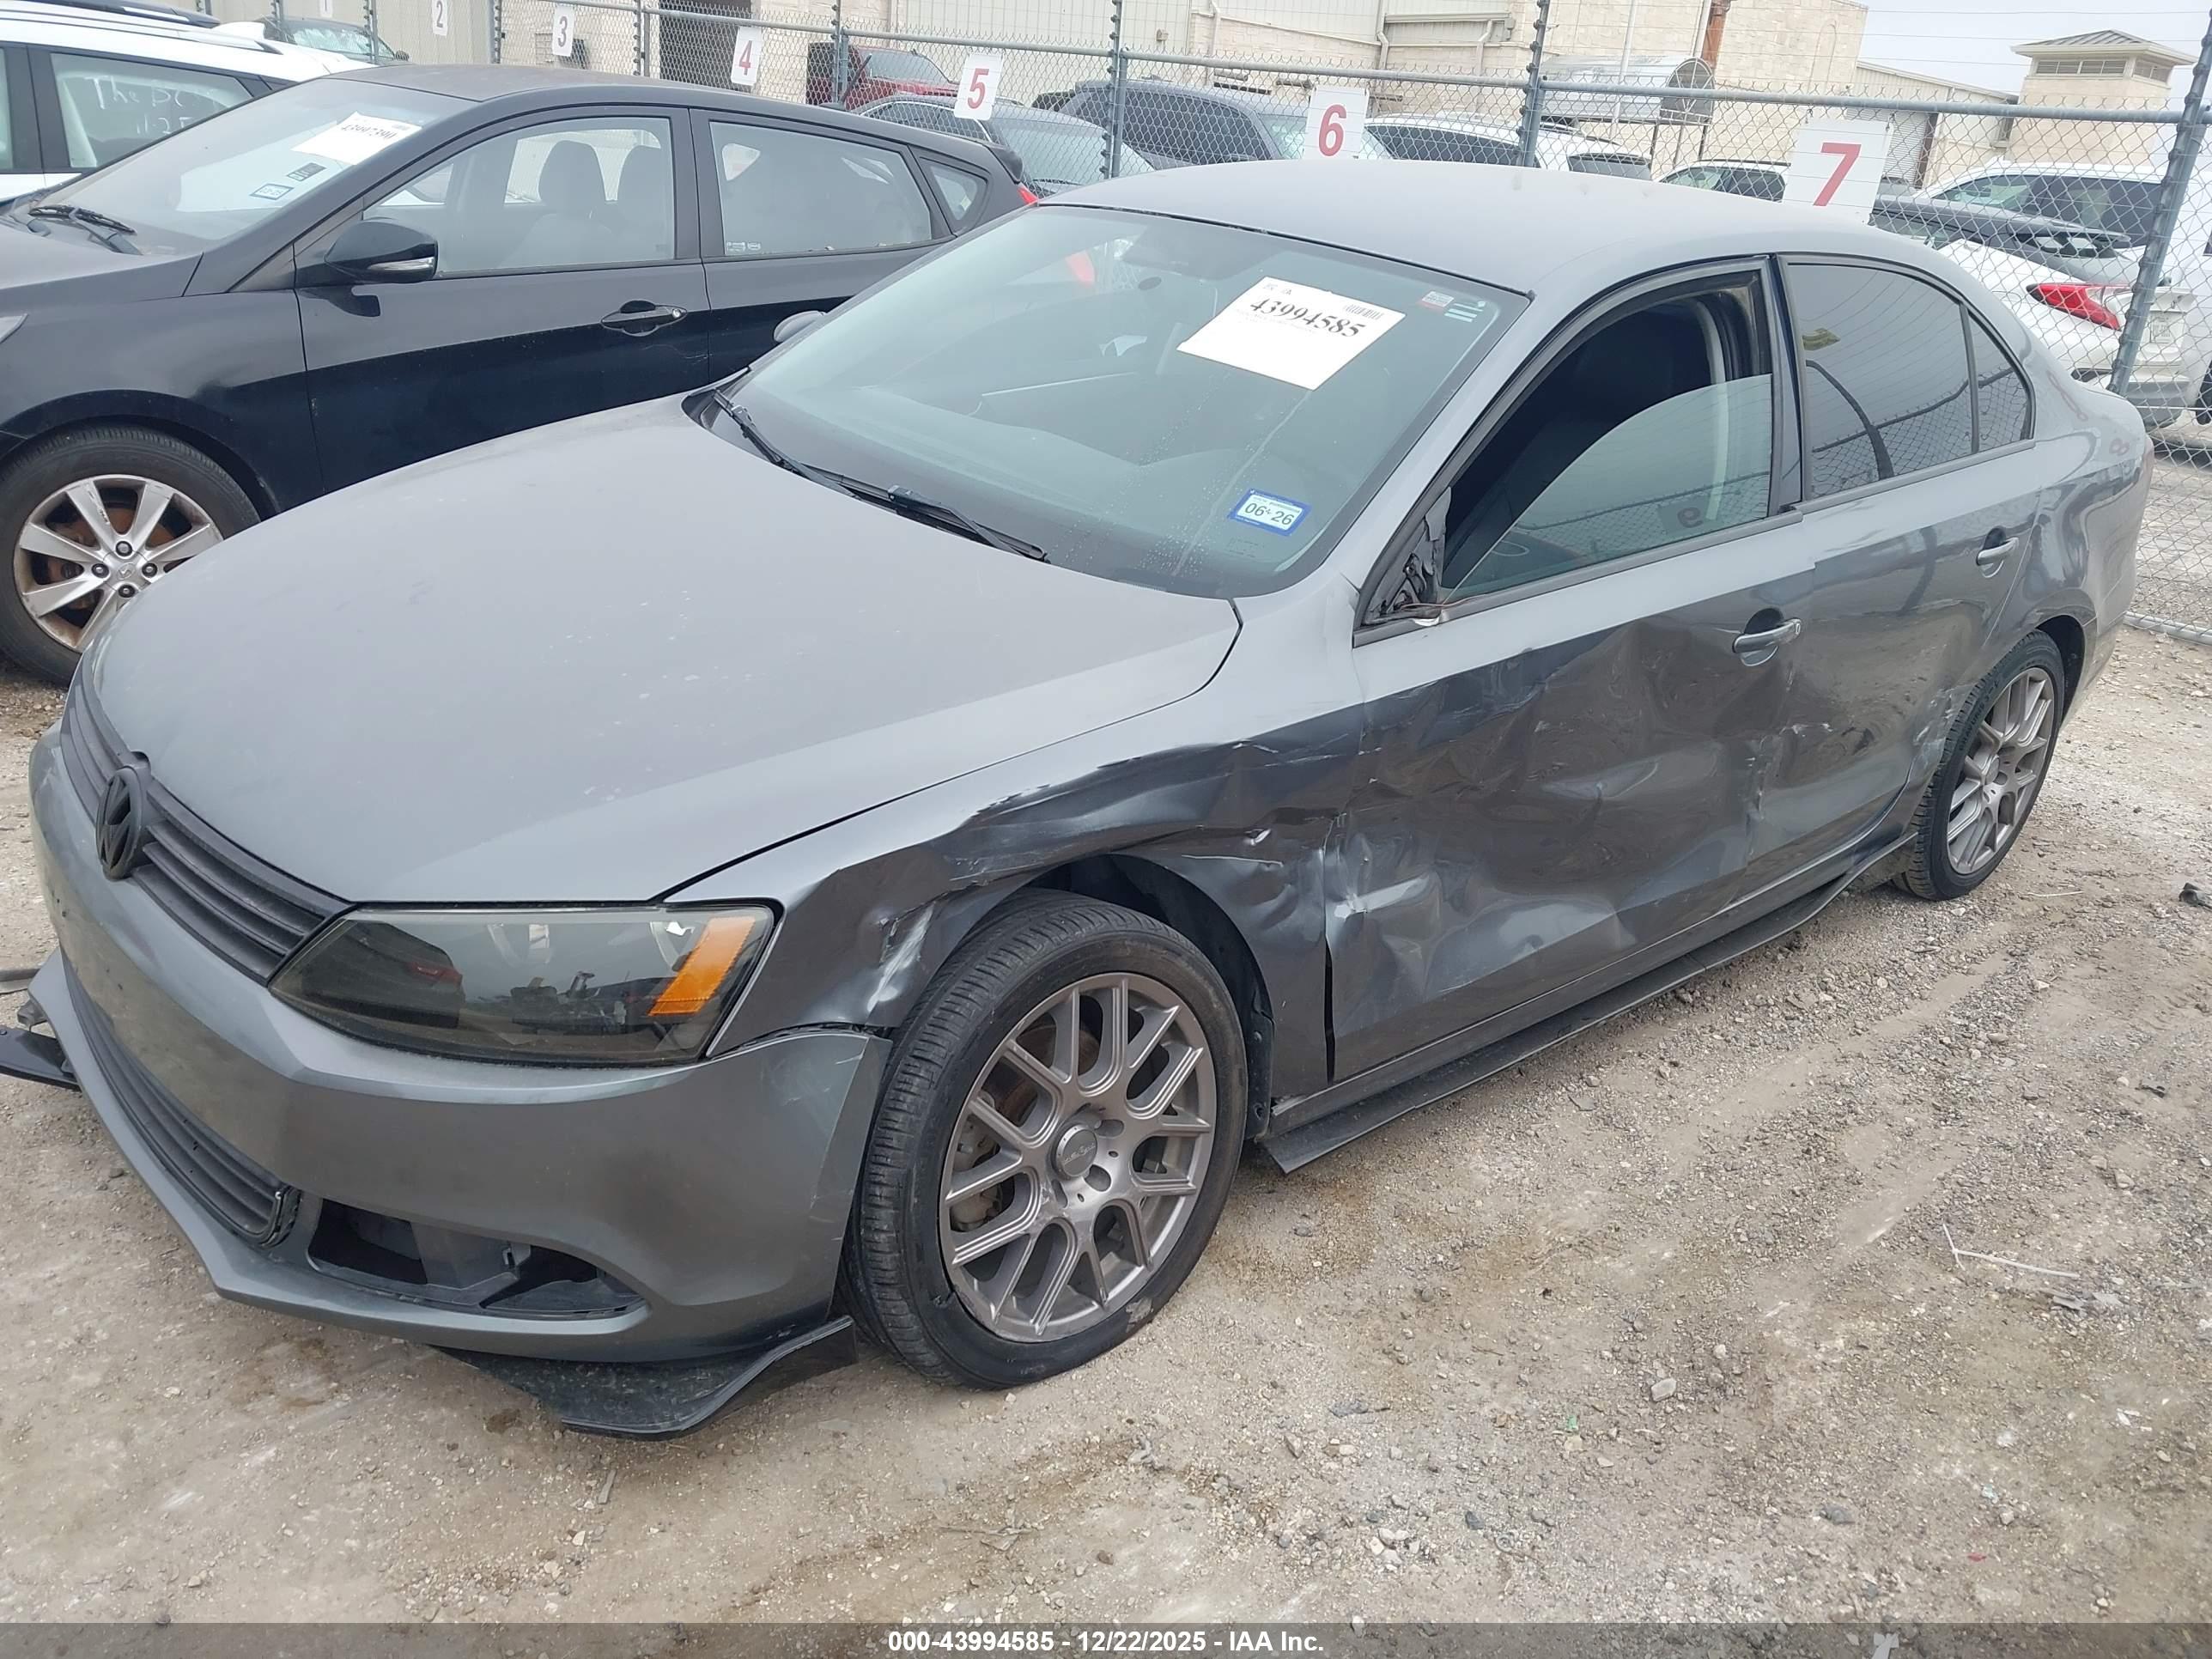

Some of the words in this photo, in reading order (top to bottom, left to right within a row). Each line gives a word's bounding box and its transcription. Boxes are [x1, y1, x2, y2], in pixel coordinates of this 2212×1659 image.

[435, 0, 444, 27] 2
[557, 15, 568, 47] 3
[738, 40, 753, 76] 4
[967, 68, 989, 109] 5
[1318, 104, 1347, 157] 6
[1813, 142, 1863, 207] 7
[1250, 298, 1367, 337] 43994585
[1244, 502, 1267, 517] 06
[1270, 510, 1295, 526] 26
